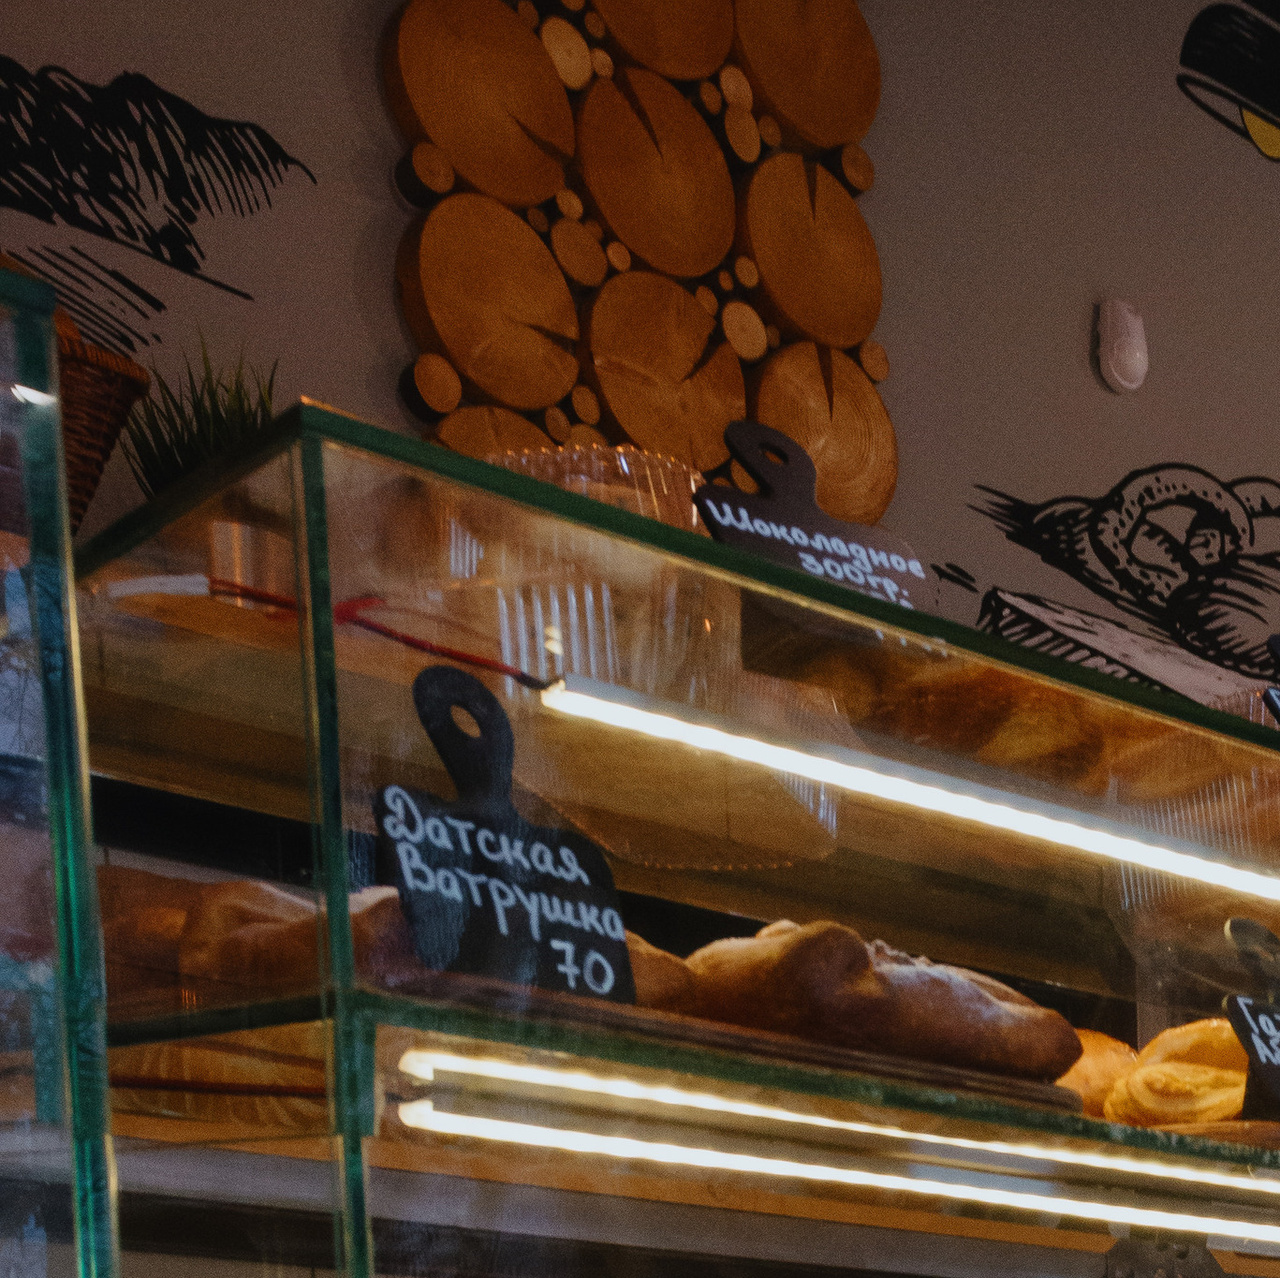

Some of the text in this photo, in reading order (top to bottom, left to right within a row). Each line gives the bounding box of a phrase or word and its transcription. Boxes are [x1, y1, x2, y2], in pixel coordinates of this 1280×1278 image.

[383, 784, 591, 886] Датская
[397, 841, 626, 942] Ватрушка
[550, 939, 616, 995] 70
